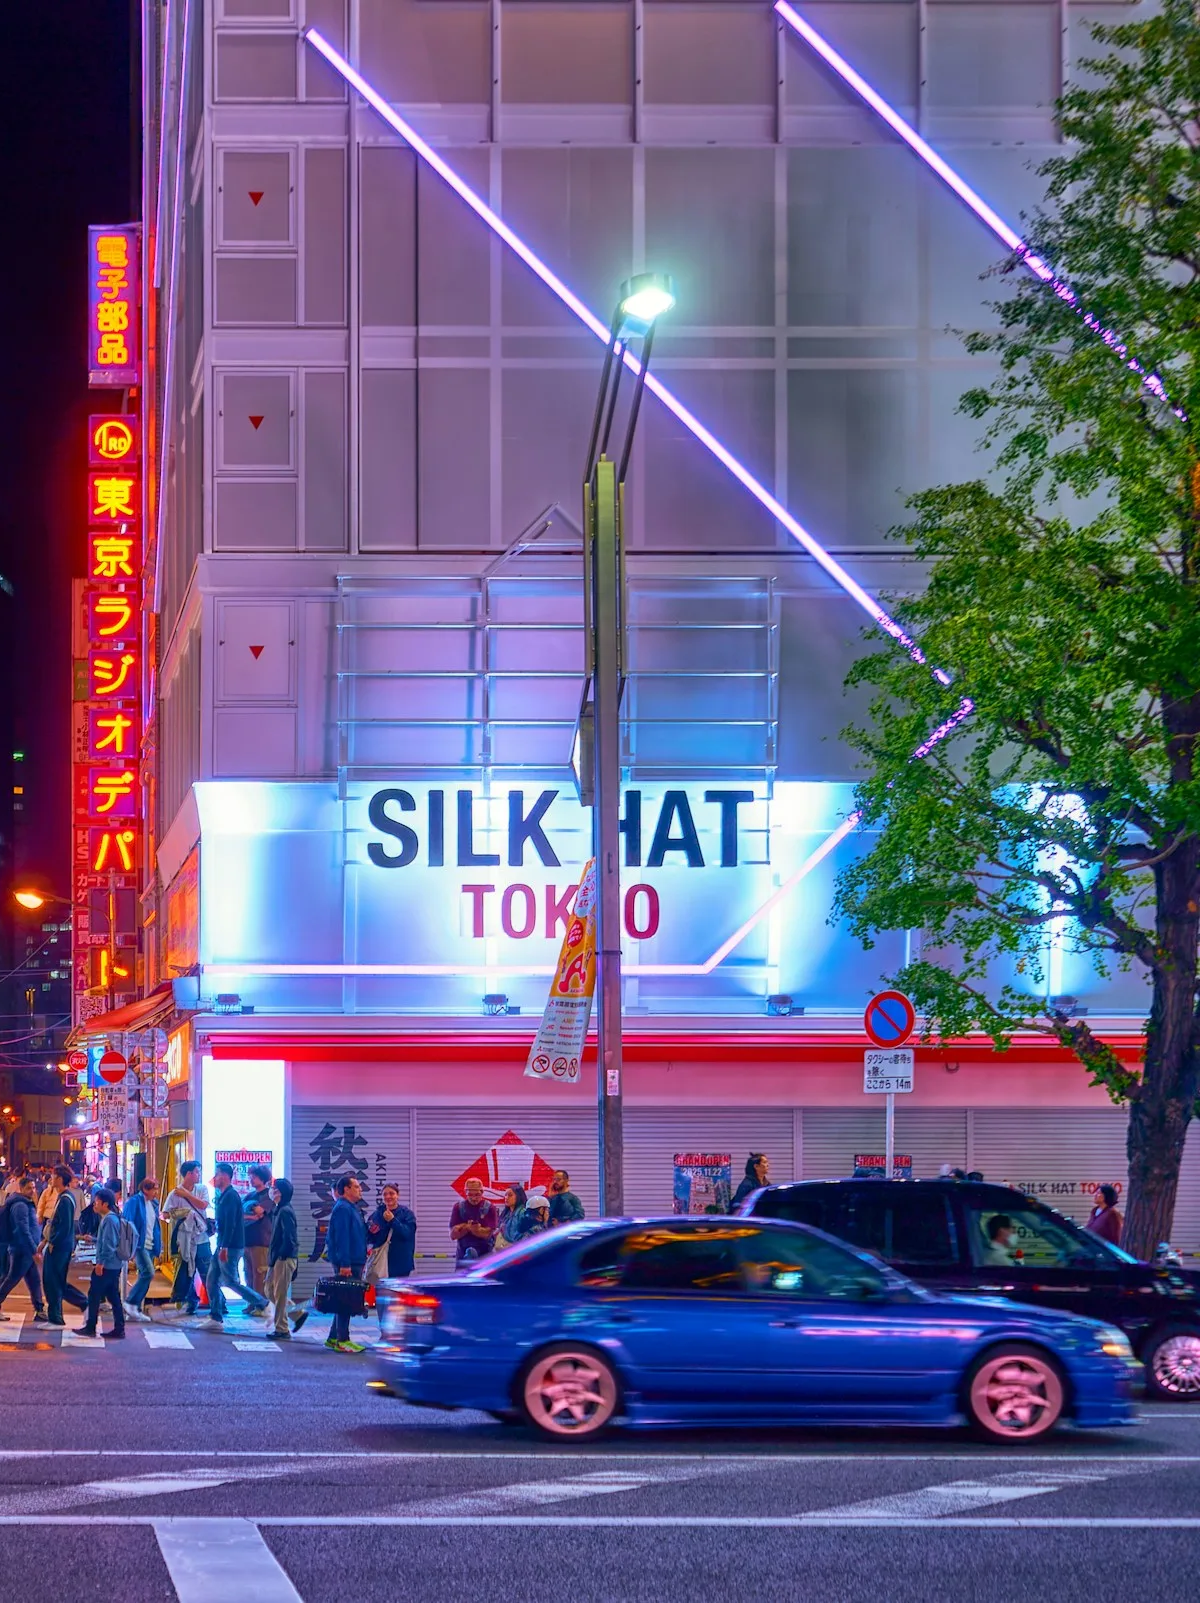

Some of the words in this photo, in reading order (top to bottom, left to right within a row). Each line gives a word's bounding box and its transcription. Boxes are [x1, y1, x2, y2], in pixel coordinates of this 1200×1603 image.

[95, 235, 129, 365] 電子部品
[367, 788, 561, 868] SILK
[618, 789, 754, 868] HAT
[461, 883, 660, 940] TOKO
[867, 1053, 911, 1064] タクシーの客待ち
[866, 1079, 891, 1089] ここから
[895, 1078, 911, 1089] 14m
[894, 1157, 911, 1167] PEN
[1017, 1183, 1047, 1194] SILK
[1051, 1182, 1076, 1194] HAT
[1080, 1182, 1123, 1194] TOO
